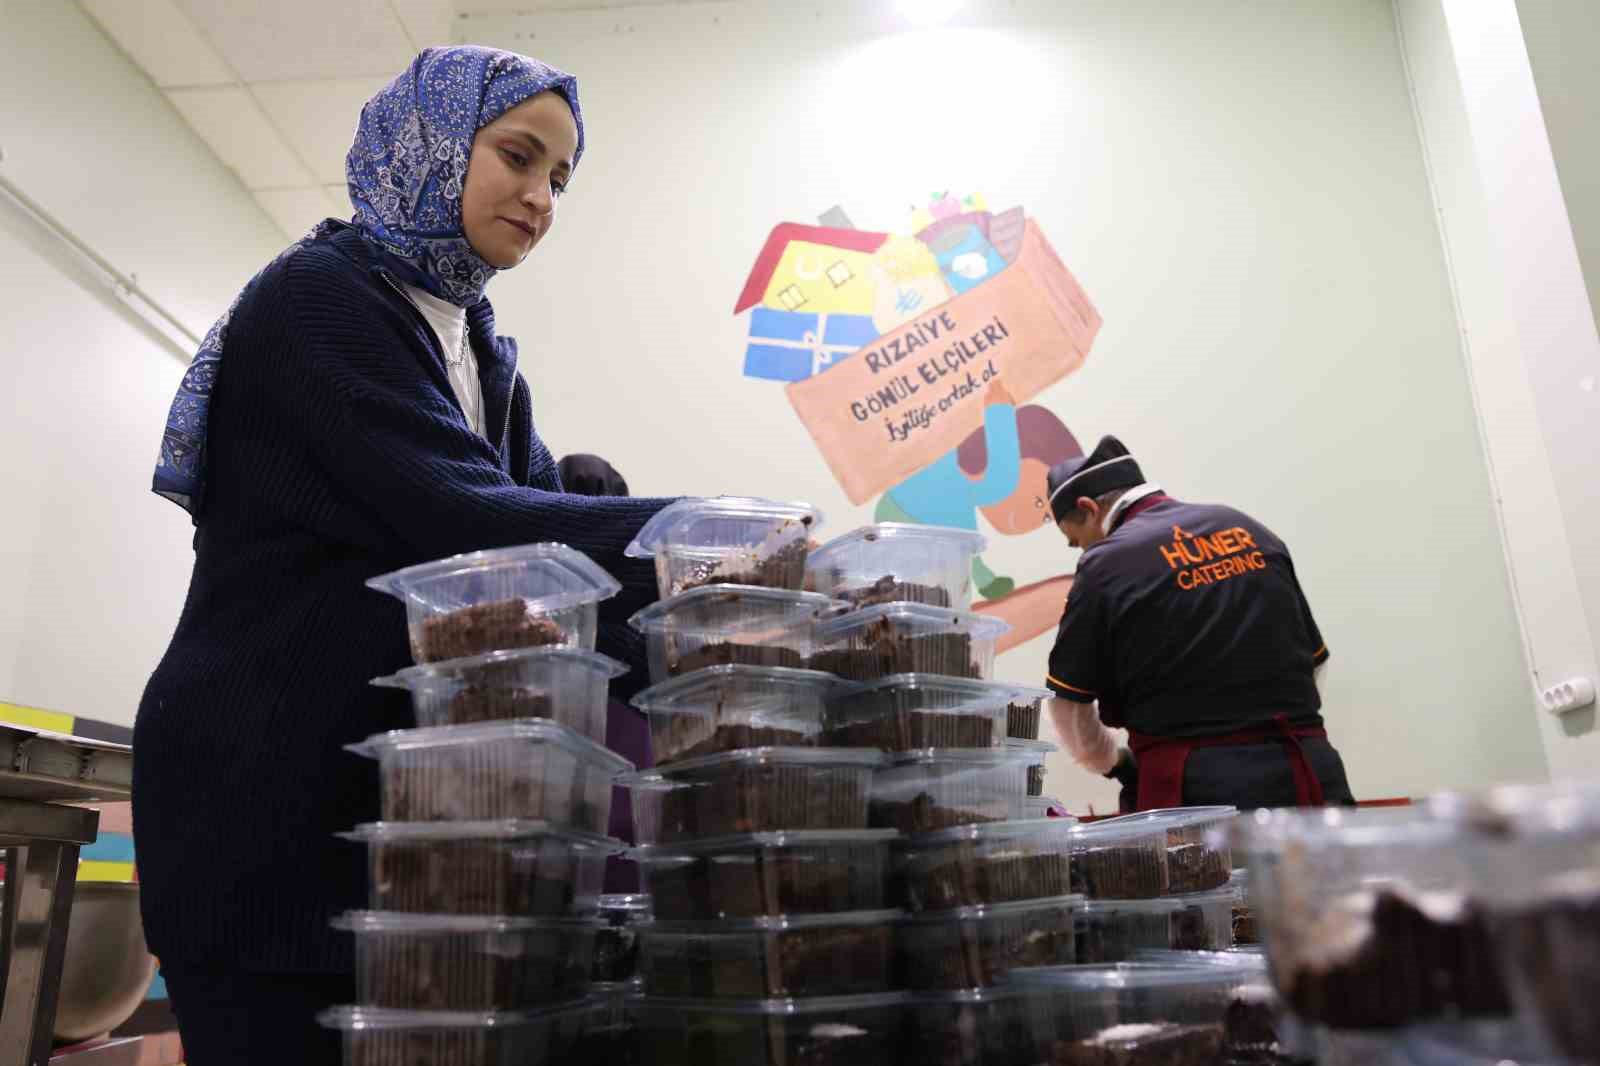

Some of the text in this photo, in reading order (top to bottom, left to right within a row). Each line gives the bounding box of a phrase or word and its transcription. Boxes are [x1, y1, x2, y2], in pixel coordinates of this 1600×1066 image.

[850, 315, 1009, 421] GÖNÜL ELÇİLERİ
[865, 311, 956, 374] RIZAİYE
[939, 371, 981, 412] ortak
[982, 359, 999, 382] ol
[1177, 551, 1266, 590] CATERING
